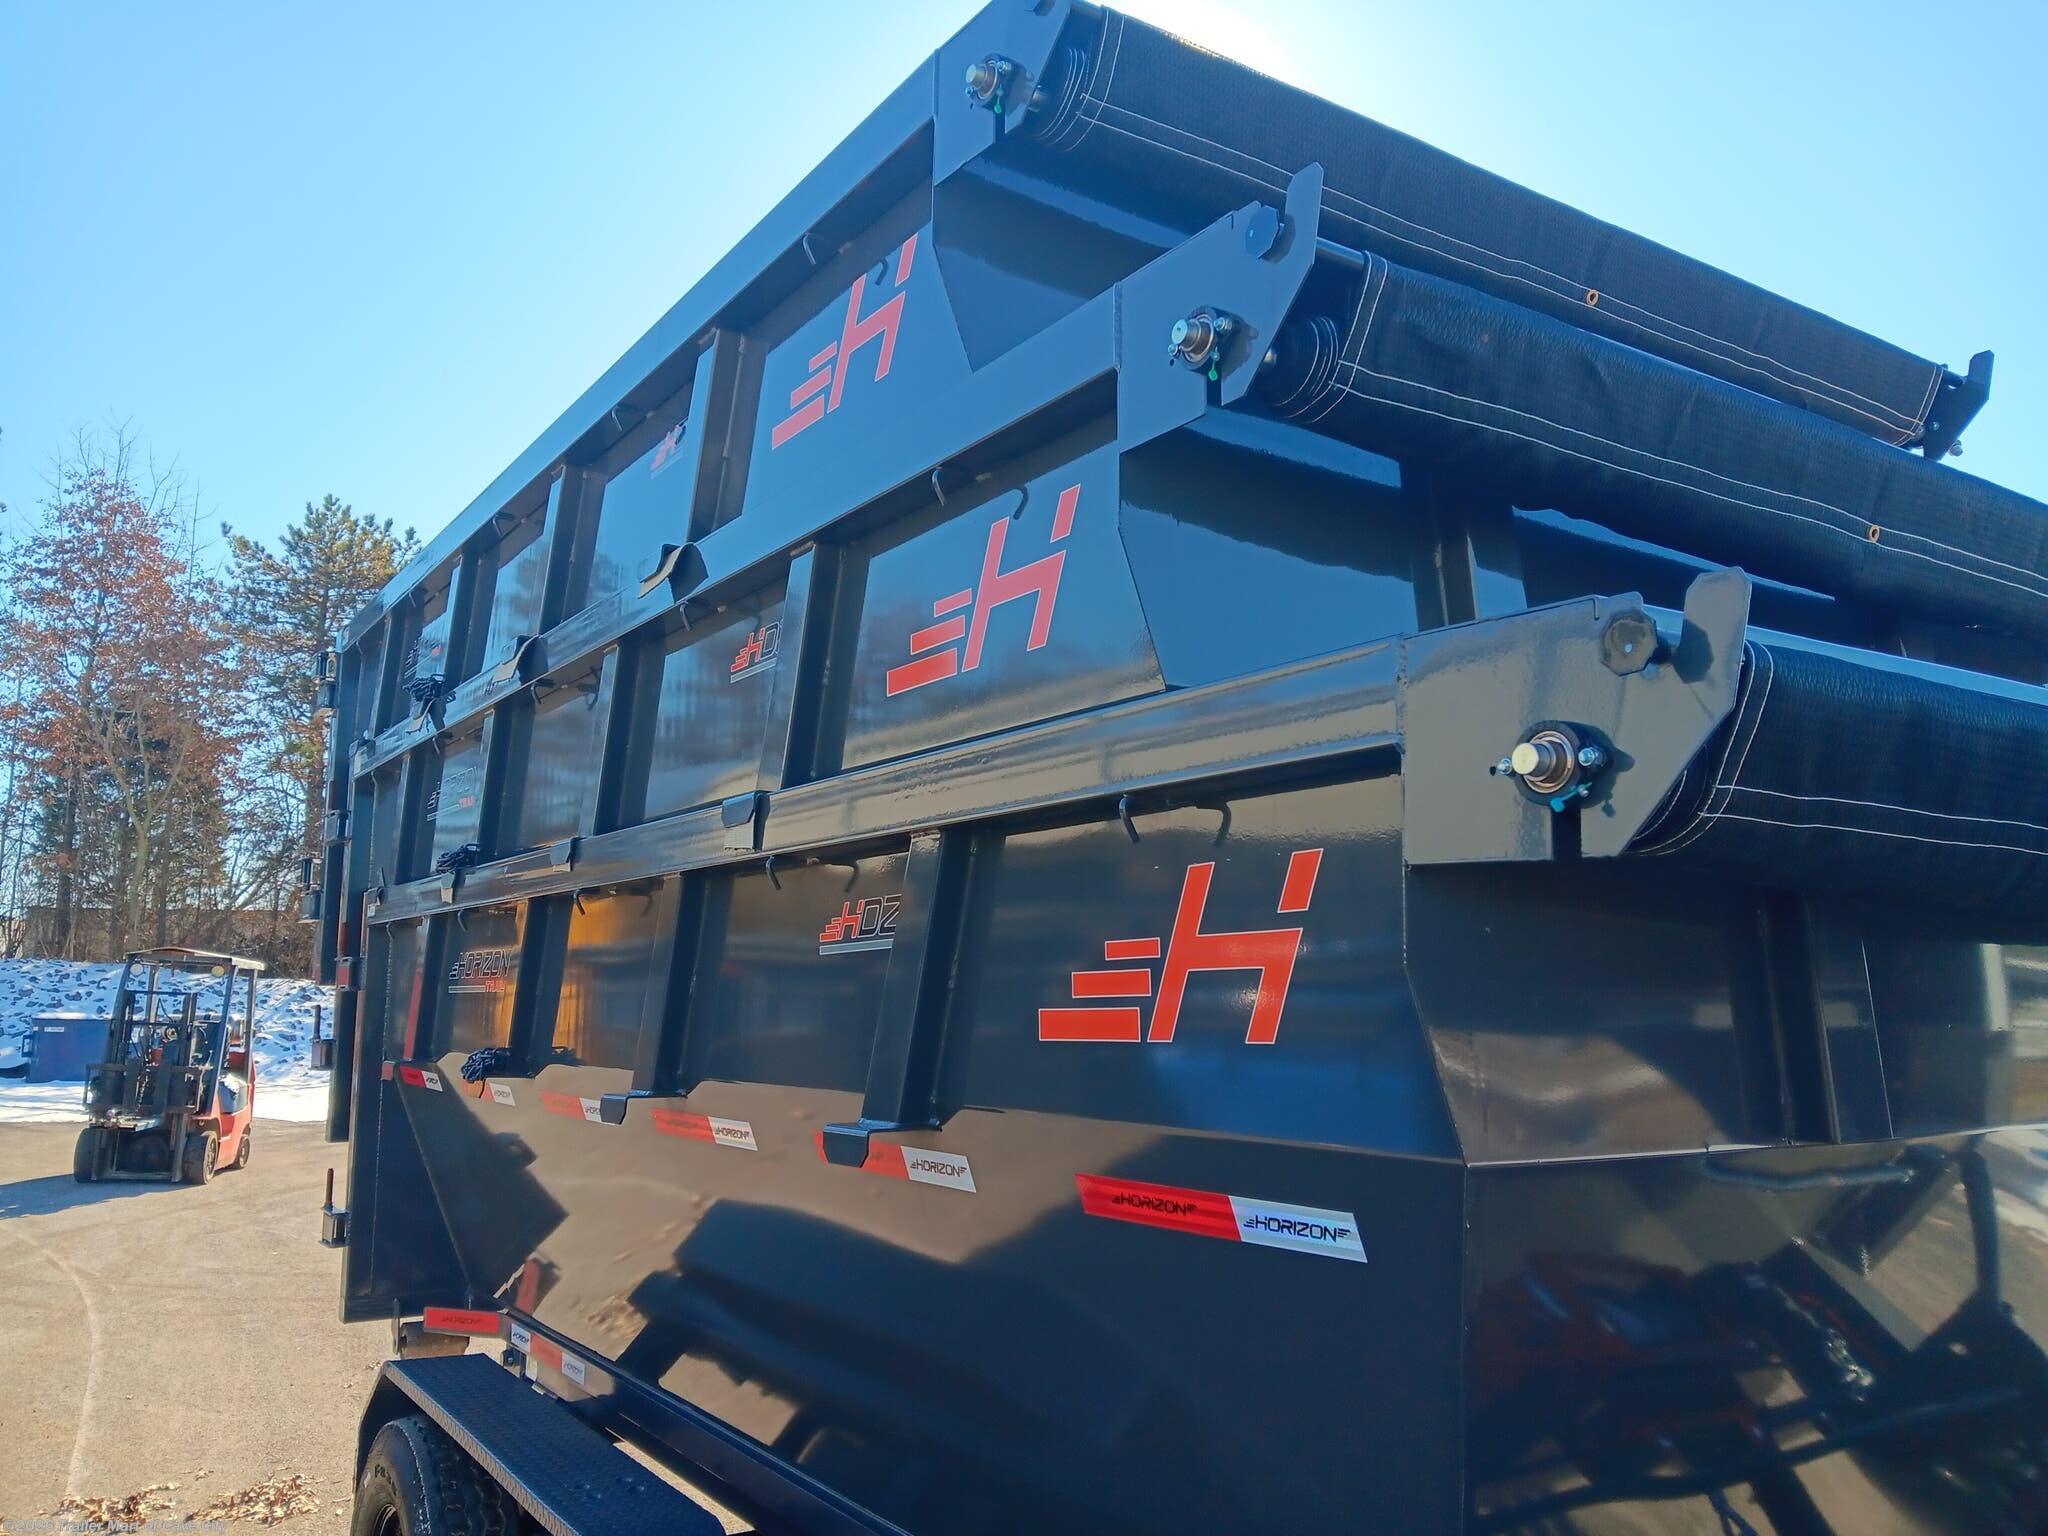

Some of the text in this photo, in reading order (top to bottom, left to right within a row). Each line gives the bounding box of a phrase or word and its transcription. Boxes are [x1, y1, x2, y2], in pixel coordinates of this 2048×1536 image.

[746, 618, 783, 667] HD
[1147, 848, 1323, 1044] H
[915, 1159, 962, 1178] HORIZON
[1119, 1191, 1338, 1243] HORIZON HORIZON
